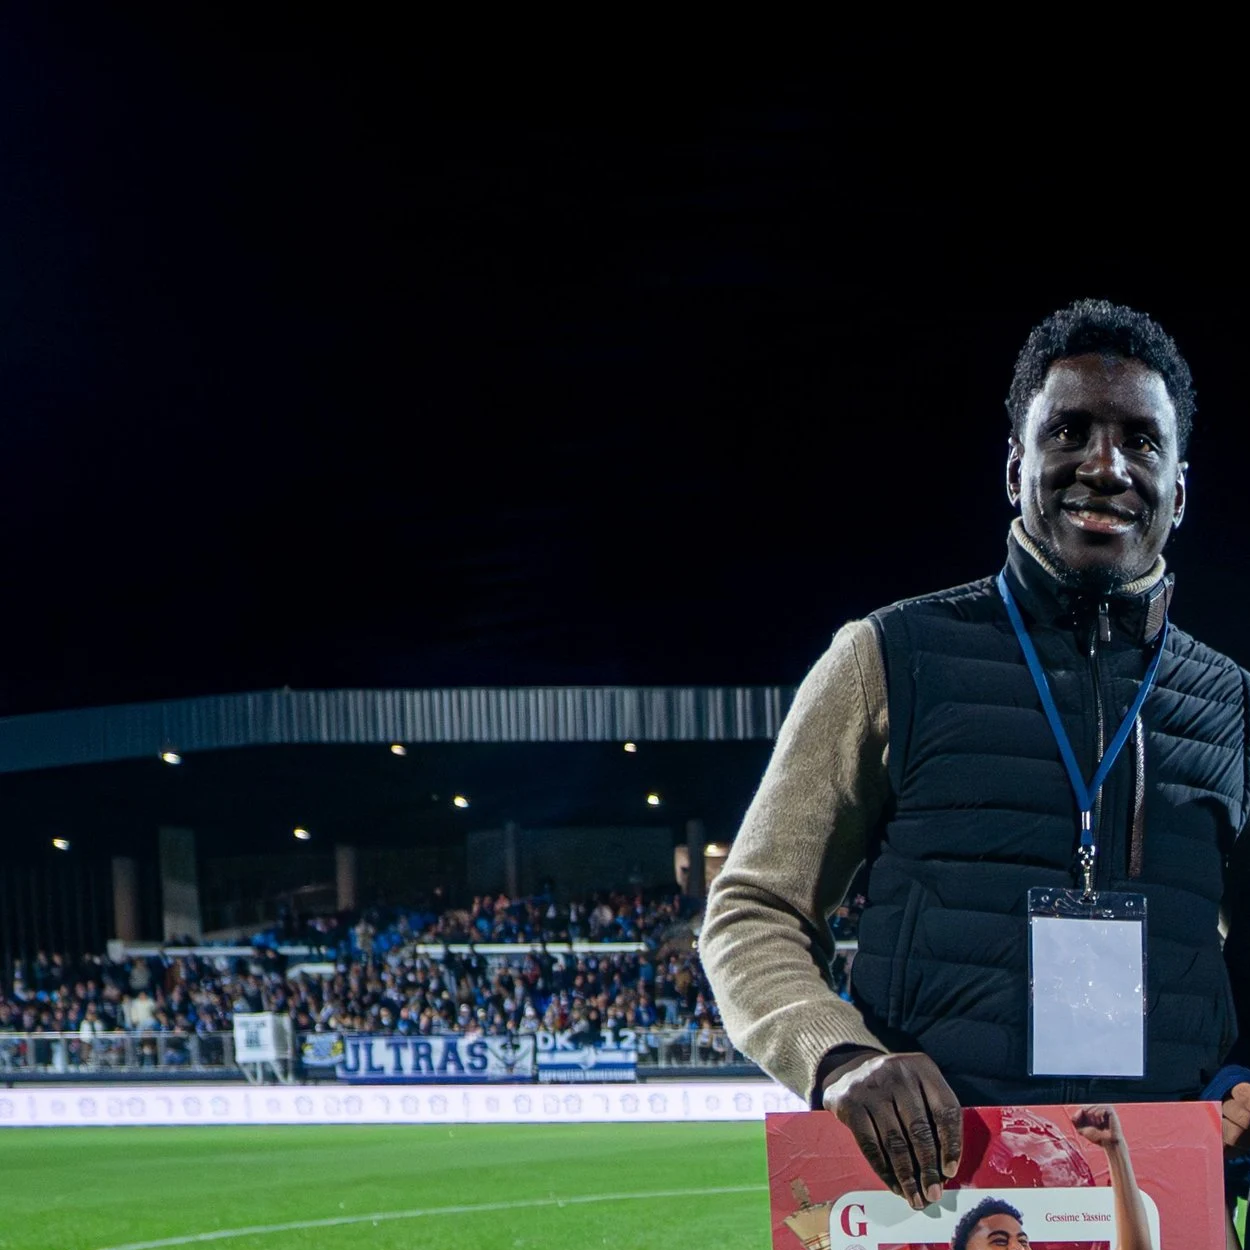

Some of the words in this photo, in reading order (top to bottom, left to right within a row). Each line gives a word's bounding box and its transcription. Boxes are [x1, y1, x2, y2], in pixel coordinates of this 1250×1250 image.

[536, 1030, 575, 1051] DK
[600, 1028, 637, 1051] 12
[342, 1040, 489, 1074] ULTRAS
[840, 1203, 868, 1238] G
[1045, 1212, 1080, 1222] Gessime
[1082, 1212, 1112, 1222] Yassine
